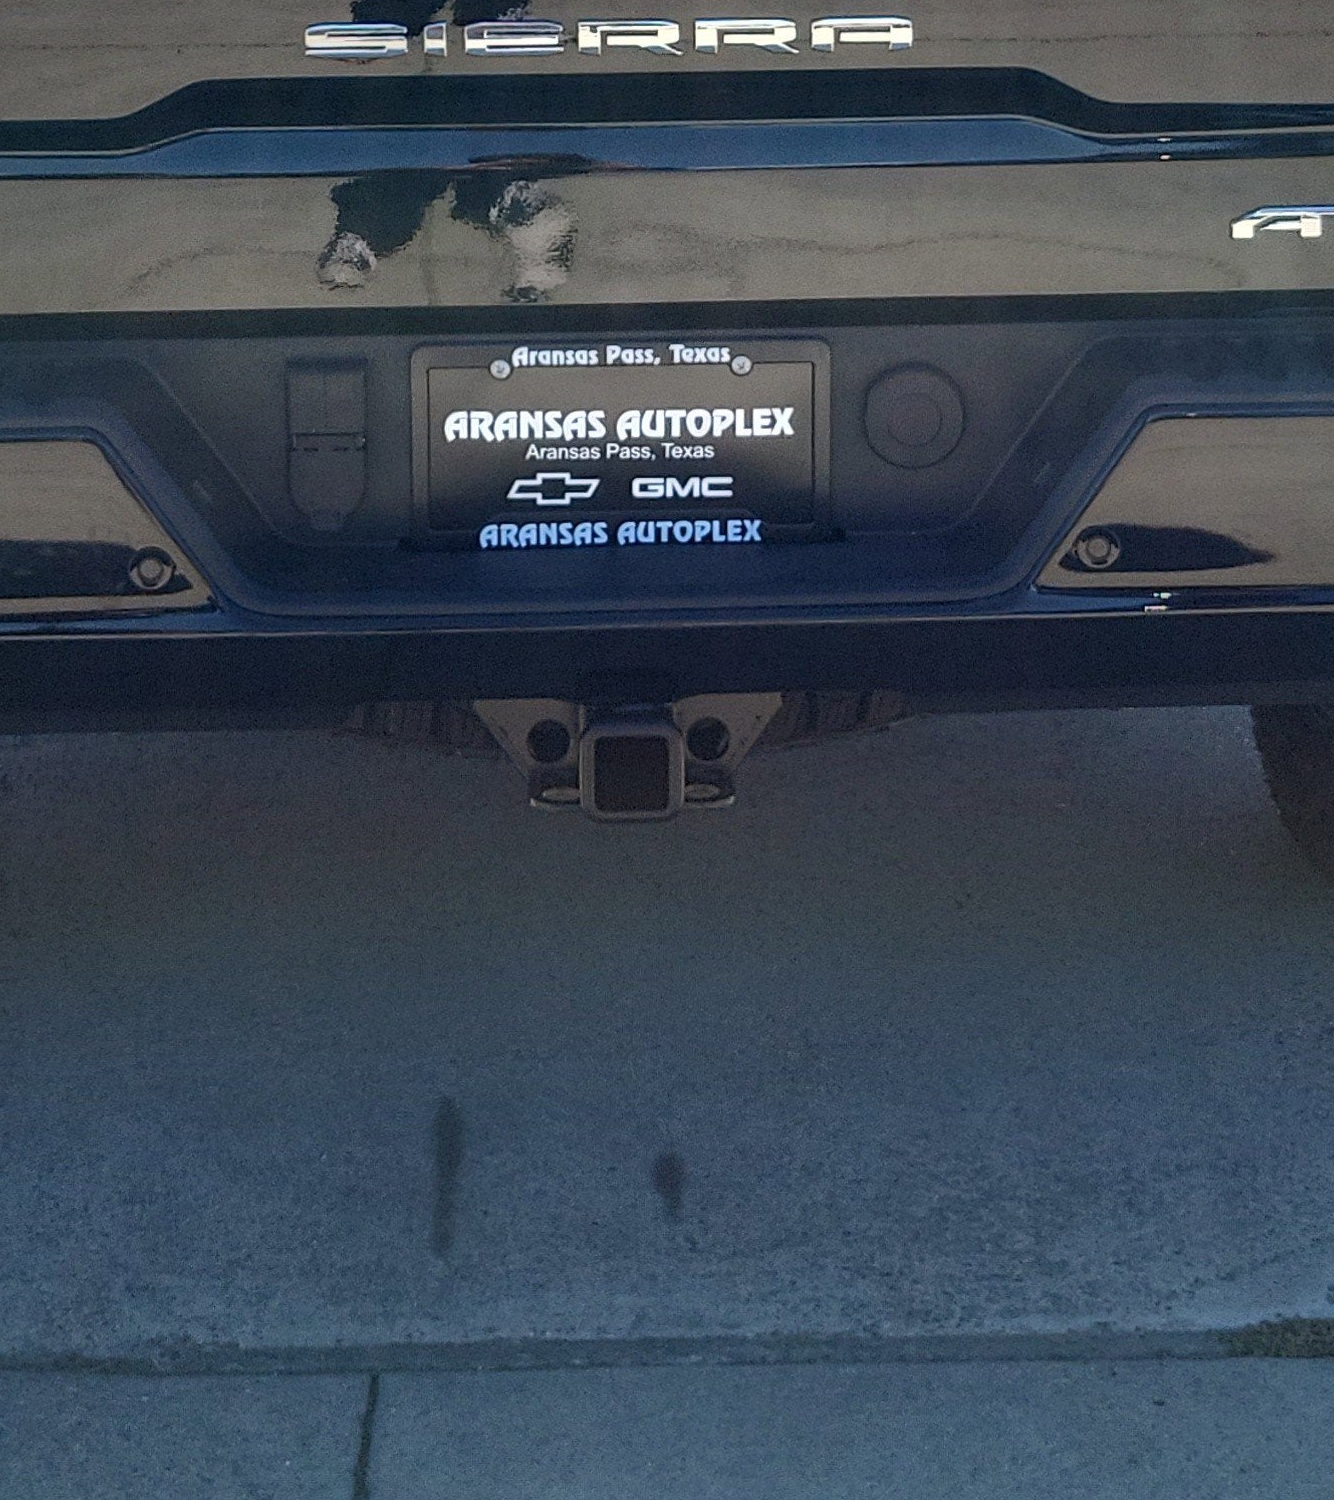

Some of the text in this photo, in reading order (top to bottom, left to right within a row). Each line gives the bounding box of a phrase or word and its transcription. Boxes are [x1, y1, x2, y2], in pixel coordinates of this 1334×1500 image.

[304, 15, 914, 58] SIERRA
[511, 343, 731, 368] Aransas Pass, Texas
[444, 407, 794, 442] ARANSAS AUTOPLEX
[525, 443, 715, 461] Aransas Pass, Texas
[631, 476, 734, 498] GMC
[479, 519, 762, 549] ARANSAS AUTOPLEX
